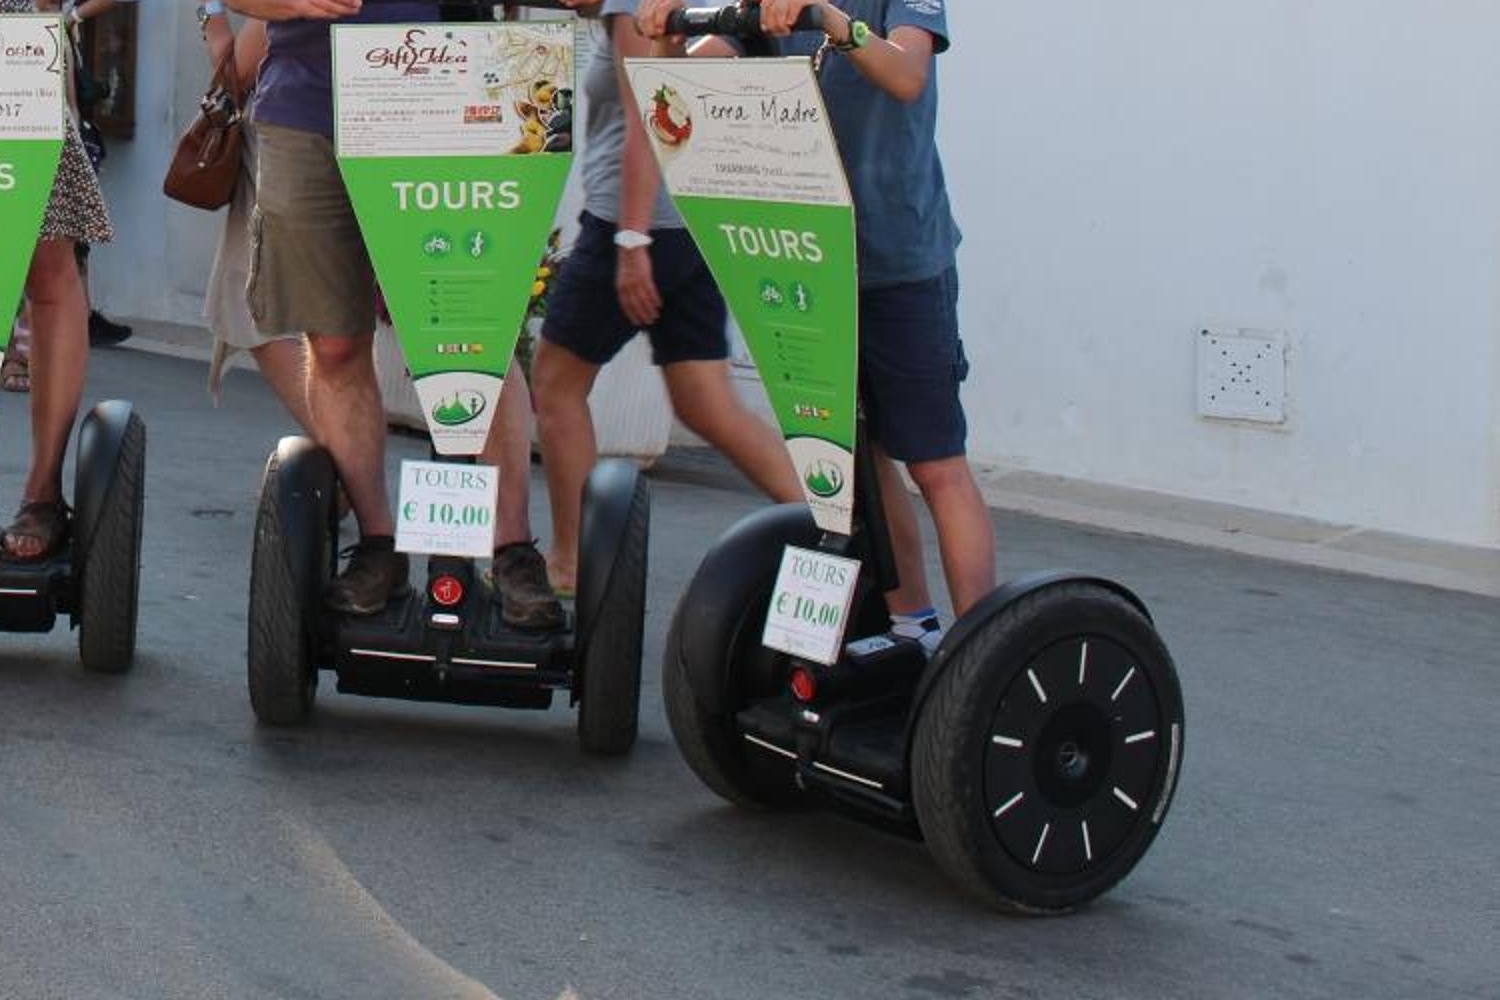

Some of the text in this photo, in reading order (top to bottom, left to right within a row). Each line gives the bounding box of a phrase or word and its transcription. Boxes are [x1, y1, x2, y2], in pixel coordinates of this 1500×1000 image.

[697, 94, 820, 126] Terra Madre
[392, 181, 520, 210] TOURS
[719, 224, 823, 263] TOURS
[412, 467, 488, 490] TOURS
[403, 501, 418, 522] €
[790, 554, 847, 587] TOURS
[776, 591, 790, 614] €
